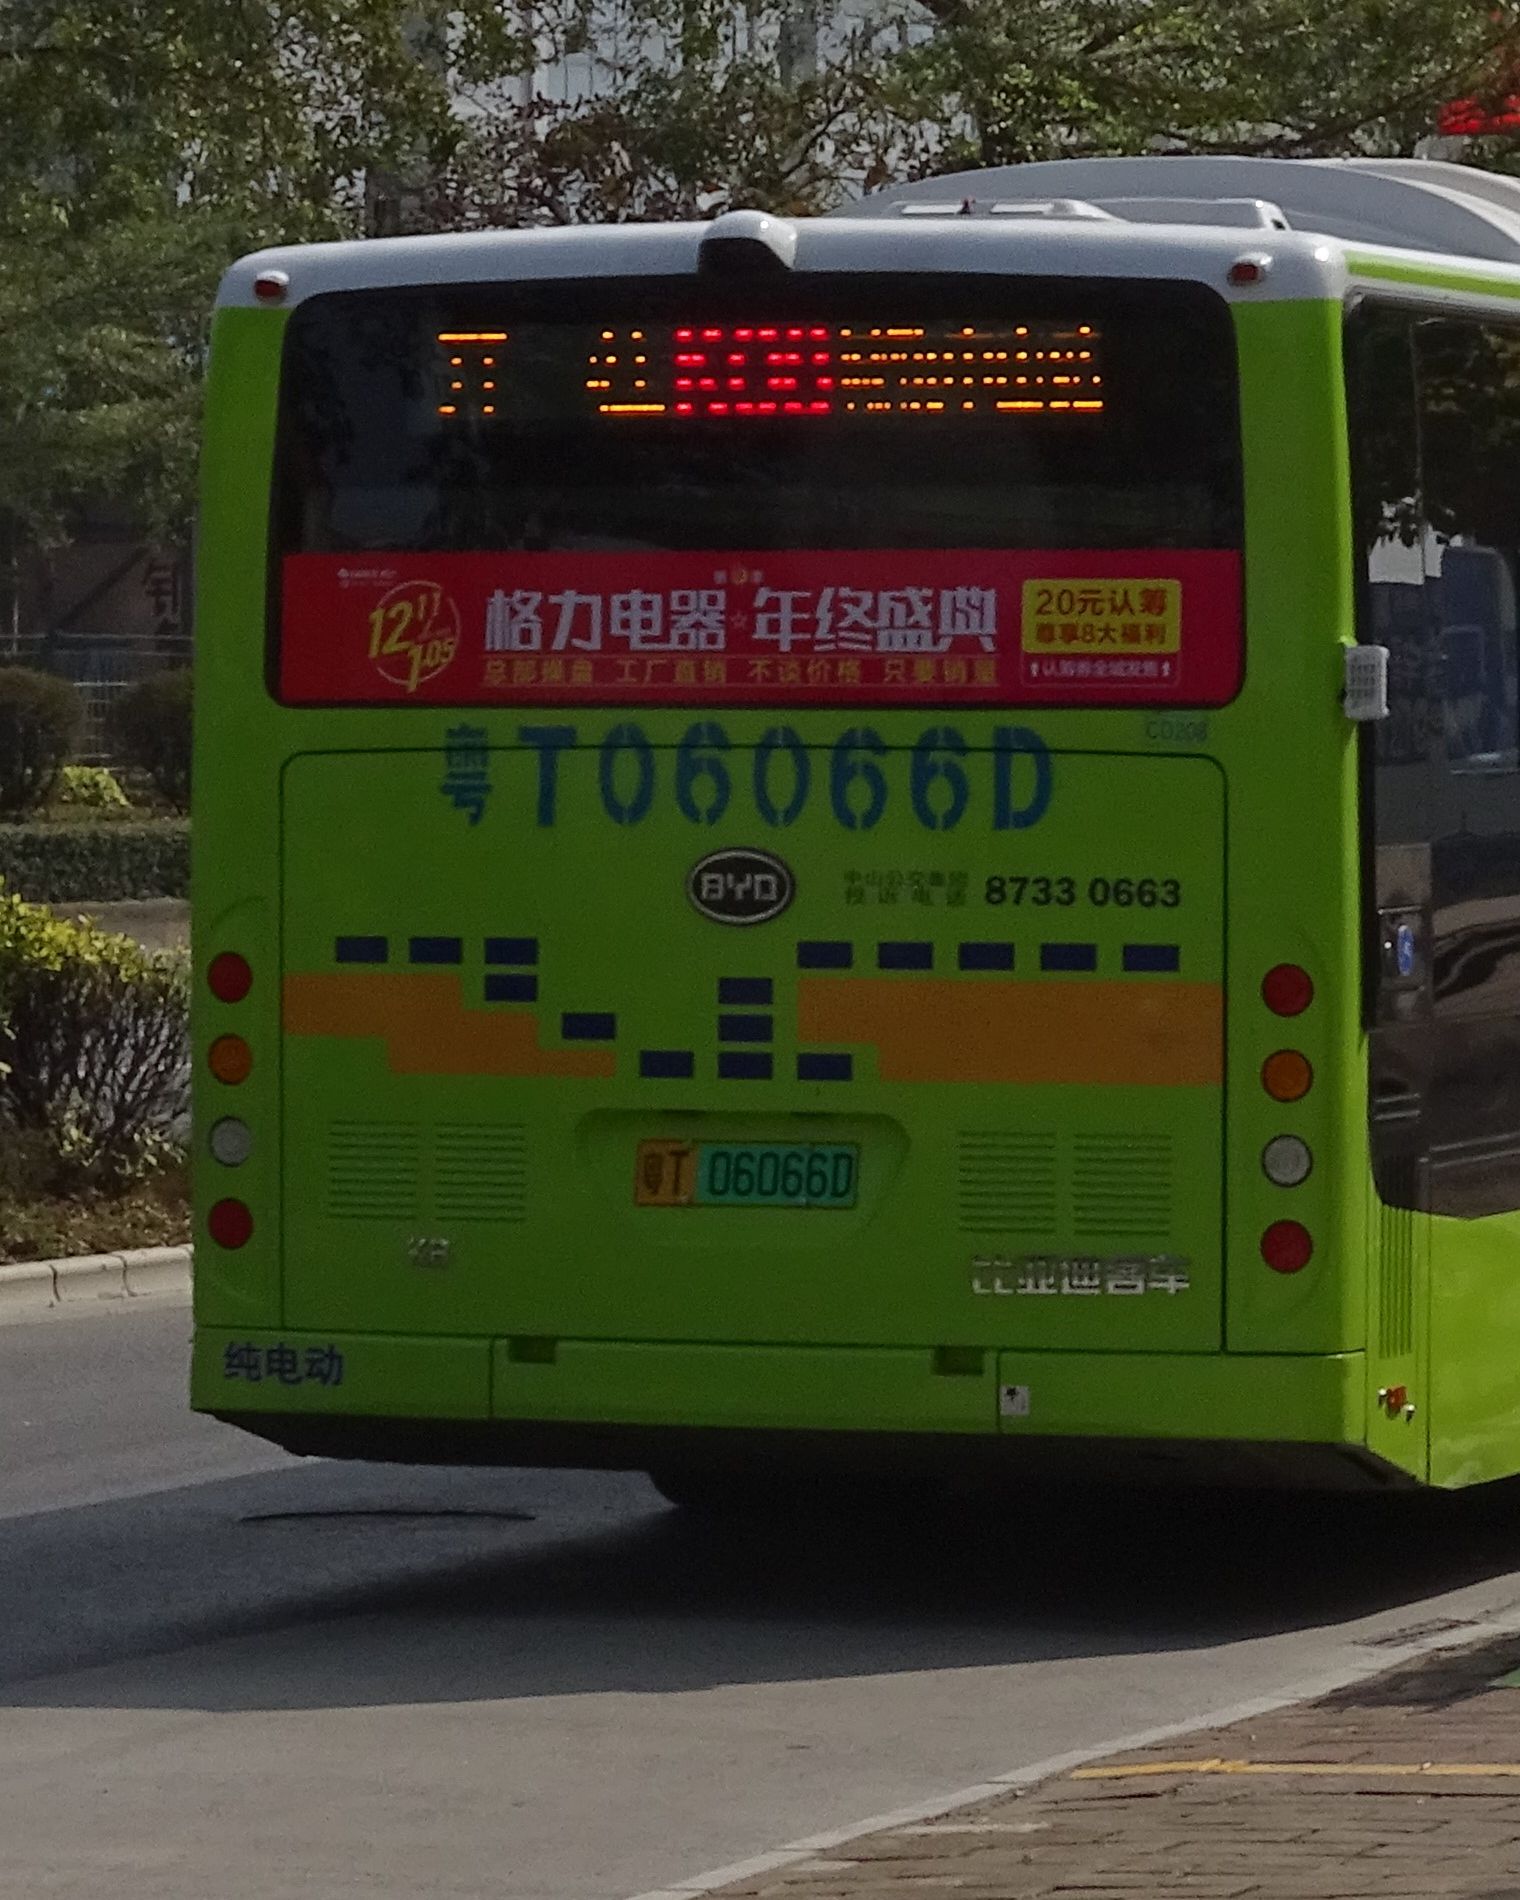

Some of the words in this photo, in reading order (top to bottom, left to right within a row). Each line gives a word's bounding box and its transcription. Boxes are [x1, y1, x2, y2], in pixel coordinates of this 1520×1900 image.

[485, 589, 727, 651] 格力电器
[752, 586, 997, 652] 年终盛典
[440, 721, 1054, 831] 粤T06066D
[699, 872, 778, 901] BYD
[984, 874, 1076, 906] 8733
[1088, 876, 1181, 908] 0663
[224, 1341, 344, 1386] 纯电动
